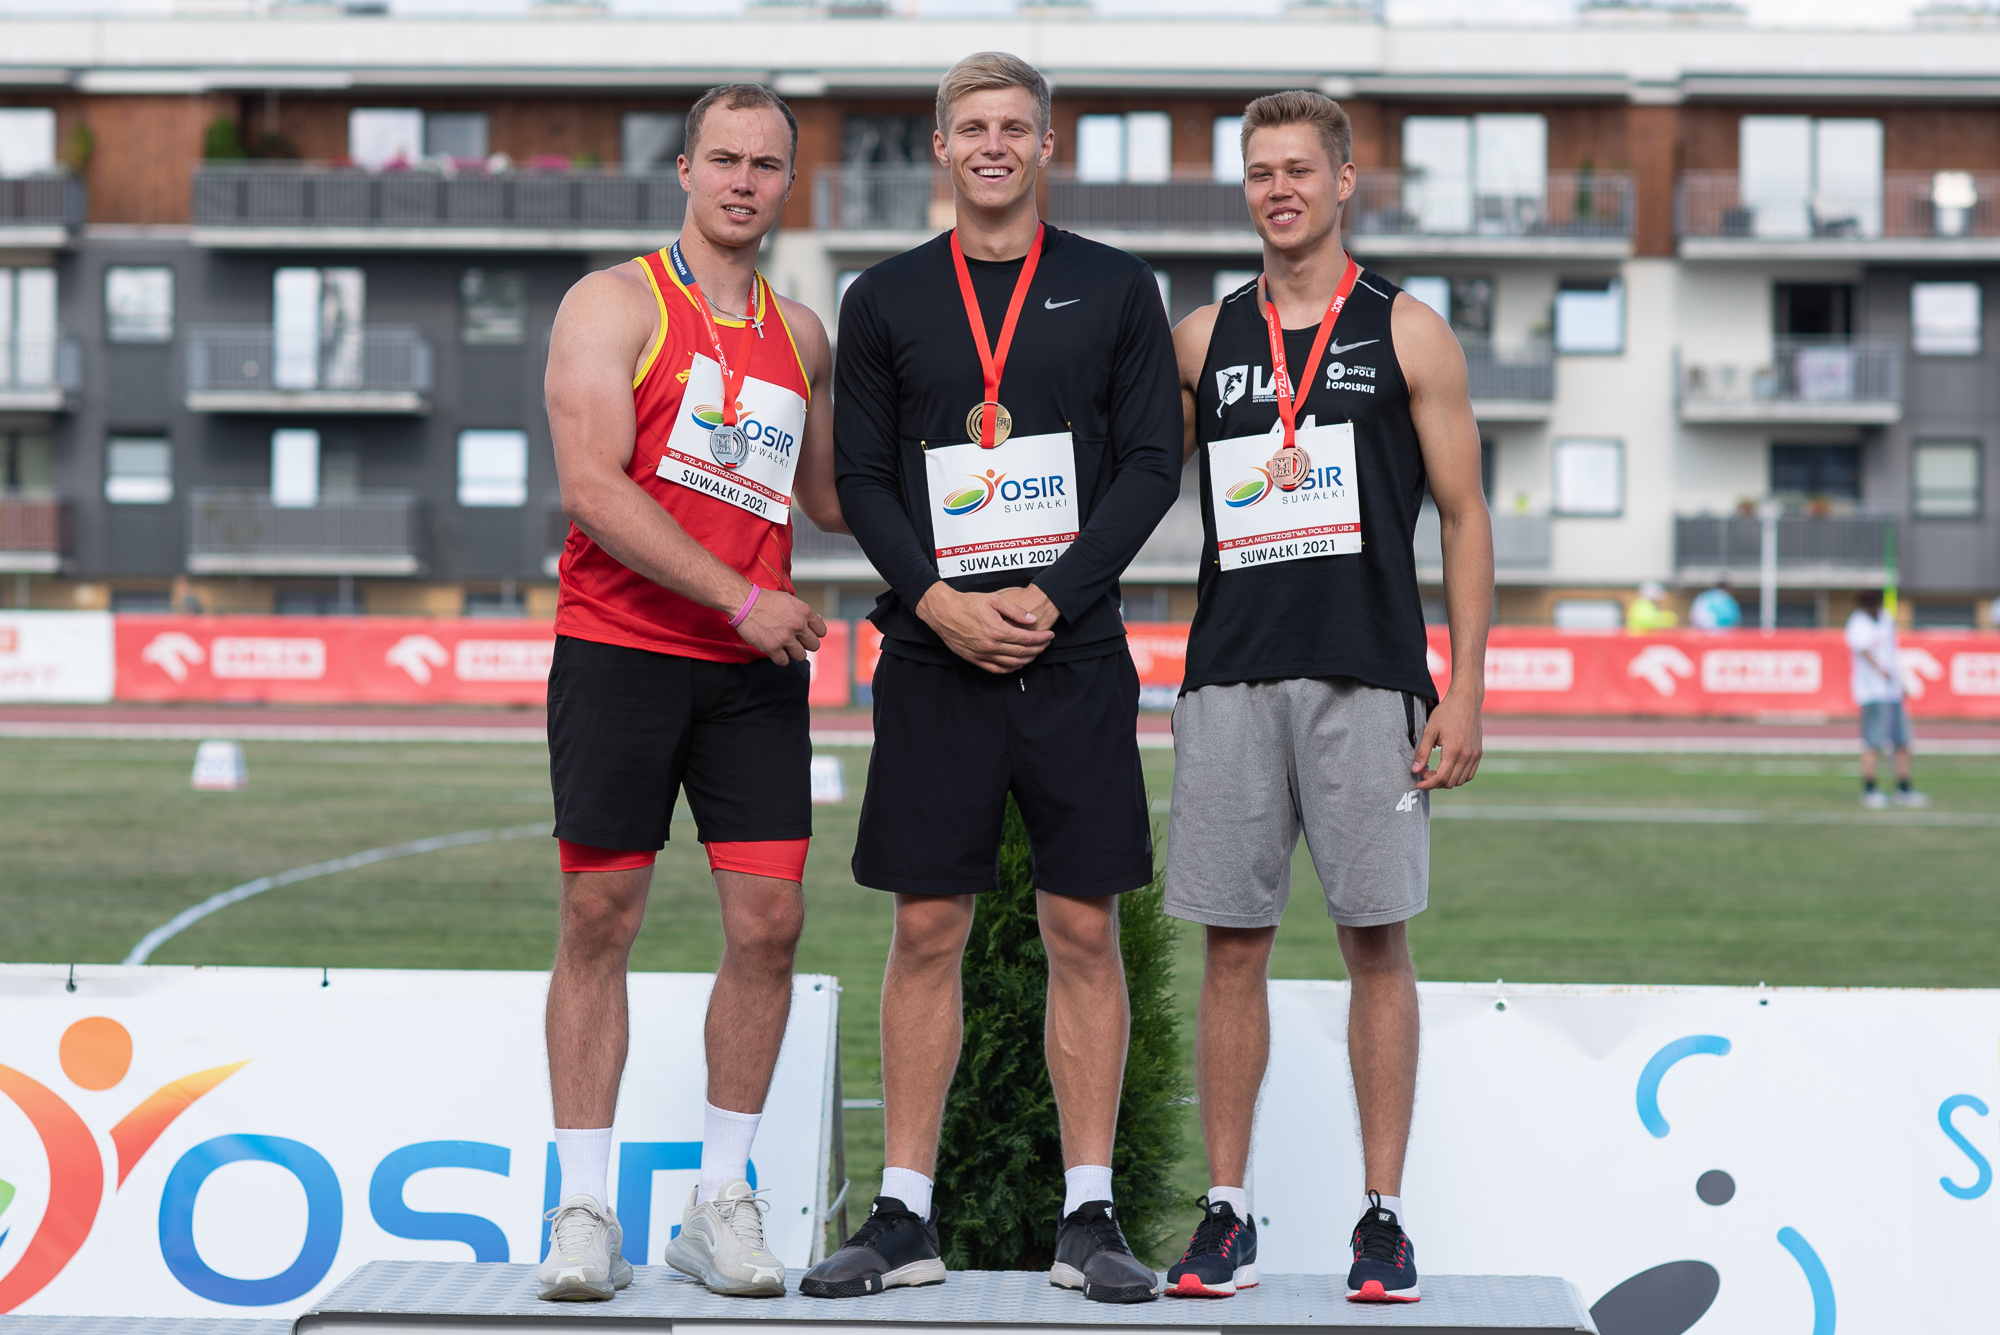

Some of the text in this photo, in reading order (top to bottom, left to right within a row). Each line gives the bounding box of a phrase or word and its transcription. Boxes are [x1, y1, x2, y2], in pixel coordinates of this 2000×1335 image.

[1331, 295, 1345, 313] MCC
[715, 344, 728, 375] PZLA
[1276, 364, 1288, 398] PZLA
[1346, 368, 1375, 378] OPOLE
[1332, 382, 1375, 393] OPOLSKIE
[743, 420, 794, 457] OSIR
[750, 444, 789, 468] UWAŁKI
[669, 451, 785, 502] 38. PZLA MISTRZOSTWA POLSKI U23
[1001, 475, 1066, 501] OSIR
[1302, 466, 1343, 490] SIR
[681, 470, 767, 514] SUWAŁKI 2021
[1282, 490, 1345, 504] SUWAŁKI
[1004, 499, 1067, 513] SUWAŁKI
[955, 546, 974, 554] PZLA
[975, 539, 1033, 551] MISTRZOSTWA
[1034, 536, 1060, 544] POLSKI
[1236, 538, 1254, 546] PZLA
[1255, 529, 1308, 542] MISTRZOSTWA
[1308, 527, 1336, 535] POLSKI
[960, 549, 1059, 572] SUWAŁKI 2021
[1240, 540, 1335, 564] SUWAŁKI 2021
